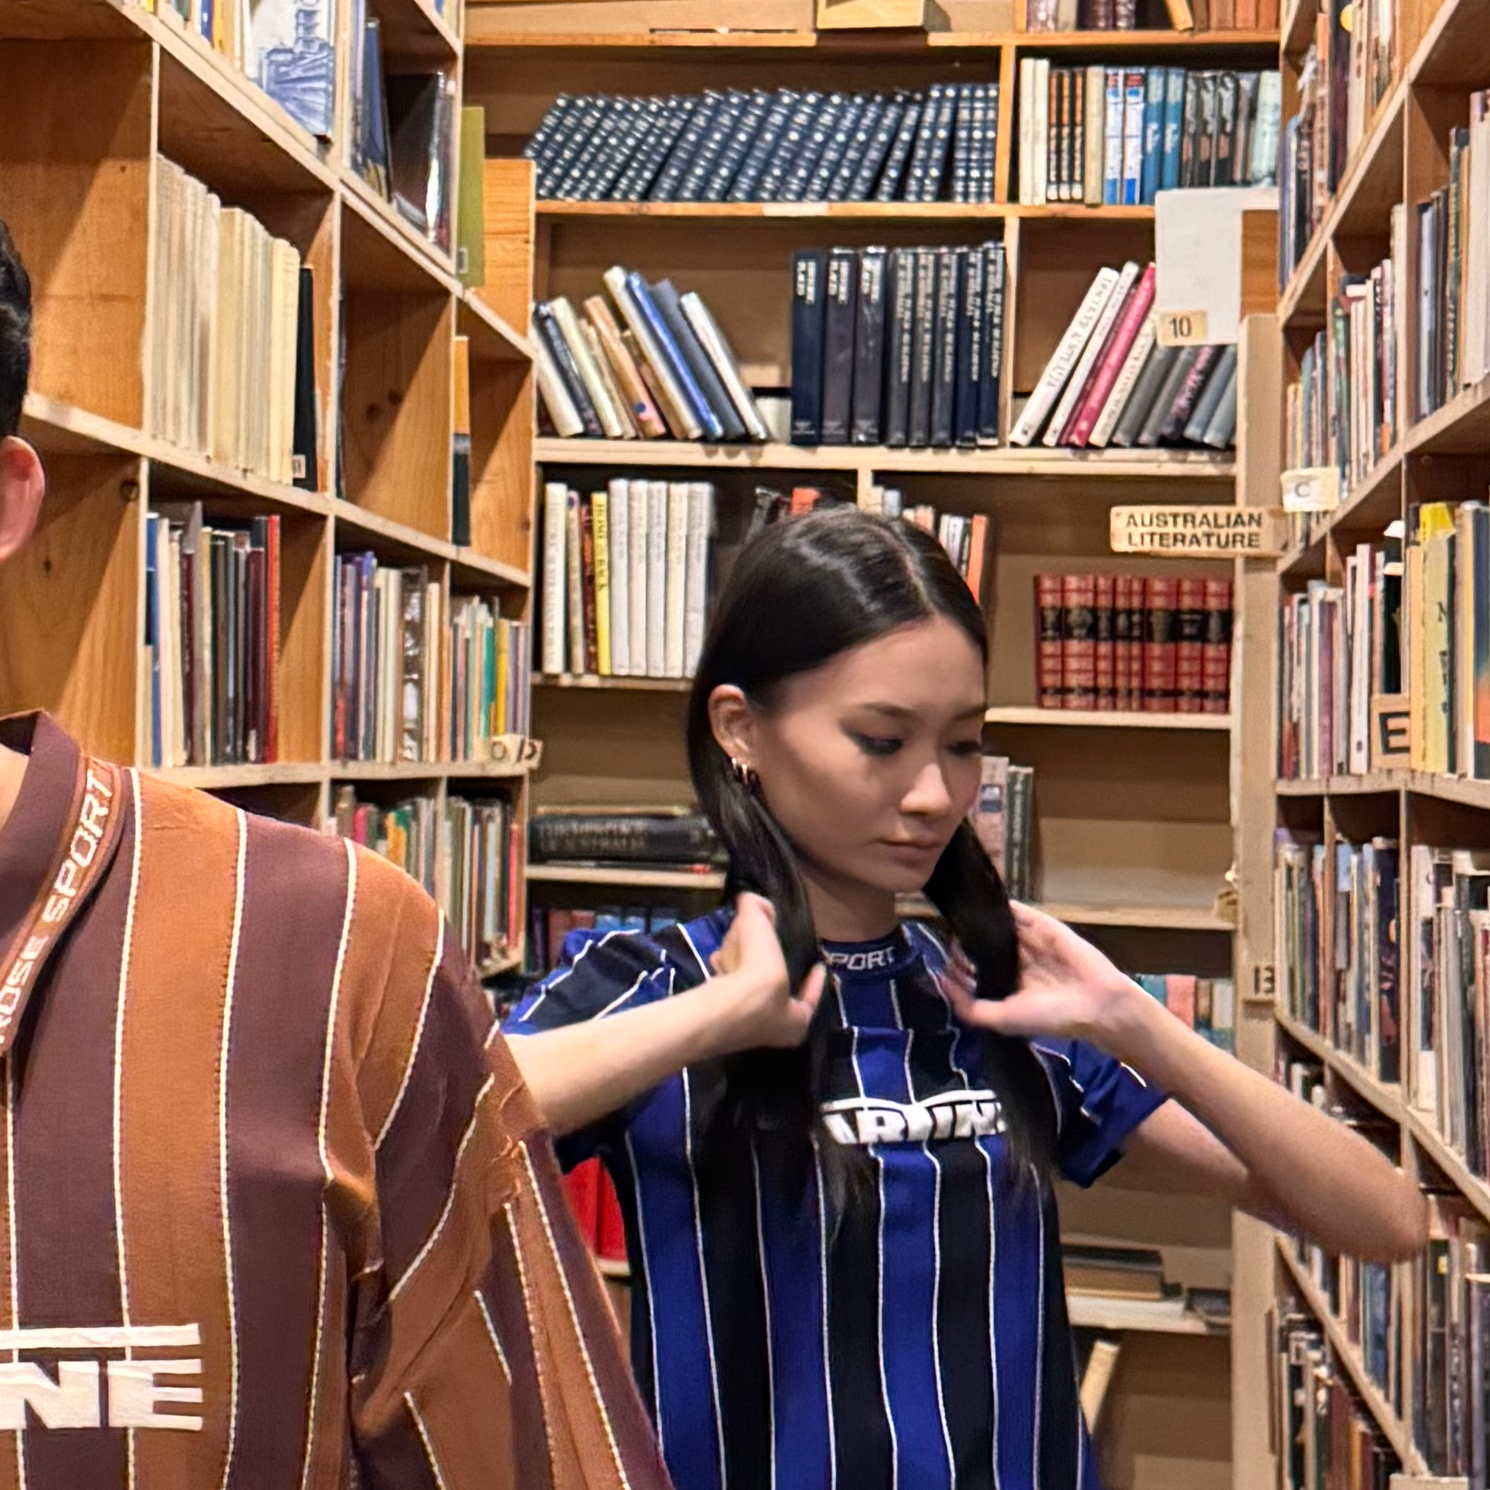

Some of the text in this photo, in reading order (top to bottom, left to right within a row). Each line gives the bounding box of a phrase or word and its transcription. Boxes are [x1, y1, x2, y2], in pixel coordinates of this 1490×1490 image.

[1169, 316, 1193, 338] 10
[1295, 481, 1310, 498] C
[1125, 511, 1263, 529] AUSTRALIAN
[1127, 531, 1261, 549] LITERATURE
[1378, 710, 1411, 755] E
[42, 769, 115, 925] SPORT
[827, 946, 896, 971] PORT
[1253, 965, 1275, 995] 13
